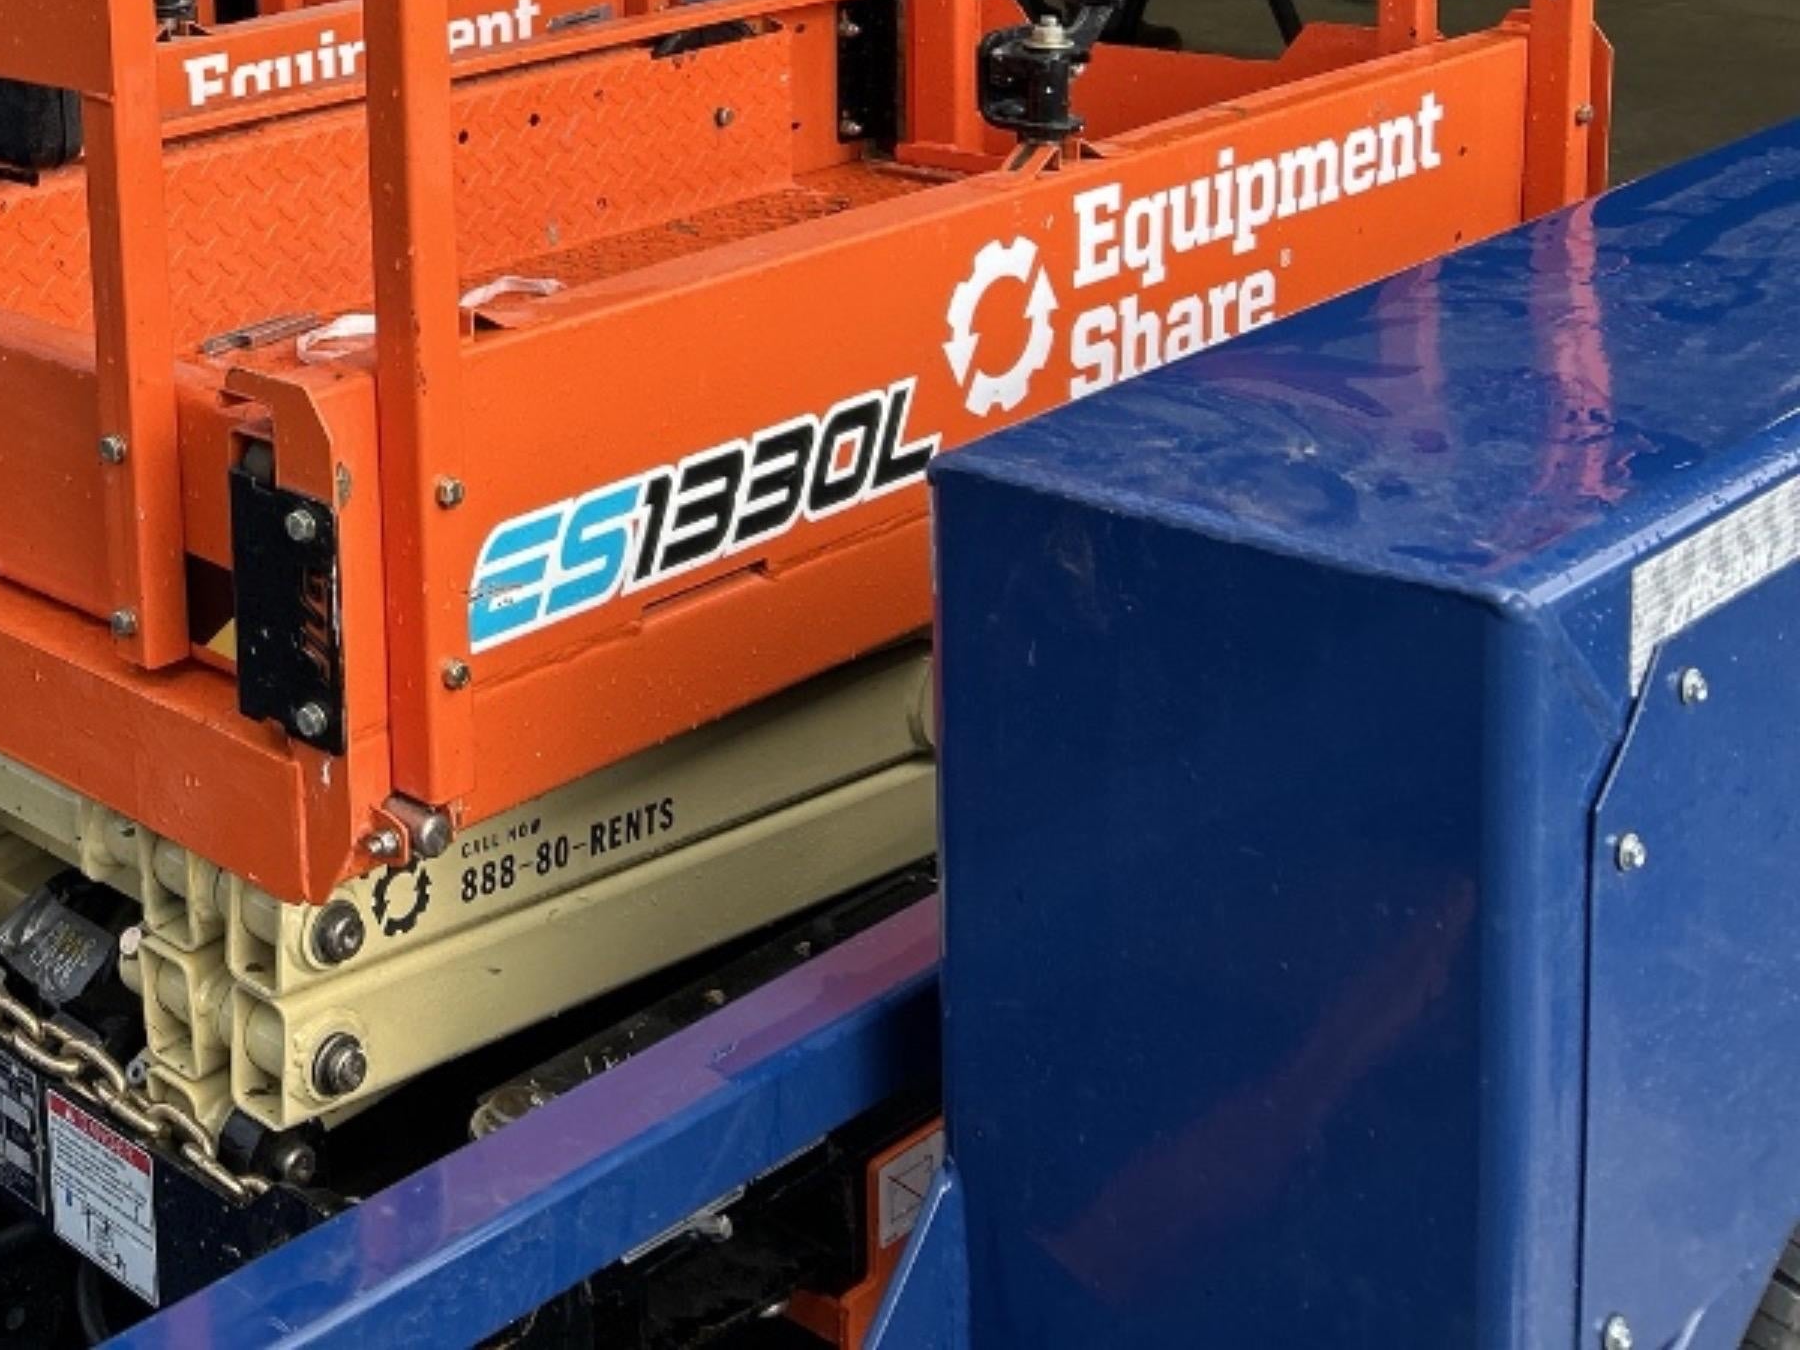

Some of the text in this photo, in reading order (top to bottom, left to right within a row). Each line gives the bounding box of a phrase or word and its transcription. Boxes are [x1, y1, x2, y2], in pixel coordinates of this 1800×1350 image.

[1073, 91, 1444, 290] Equipment
[1068, 268, 1277, 402] Share
[468, 377, 942, 654] ES1330L
[460, 832, 500, 859] CALL
[460, 797, 674, 904] 888-80-RENTS
